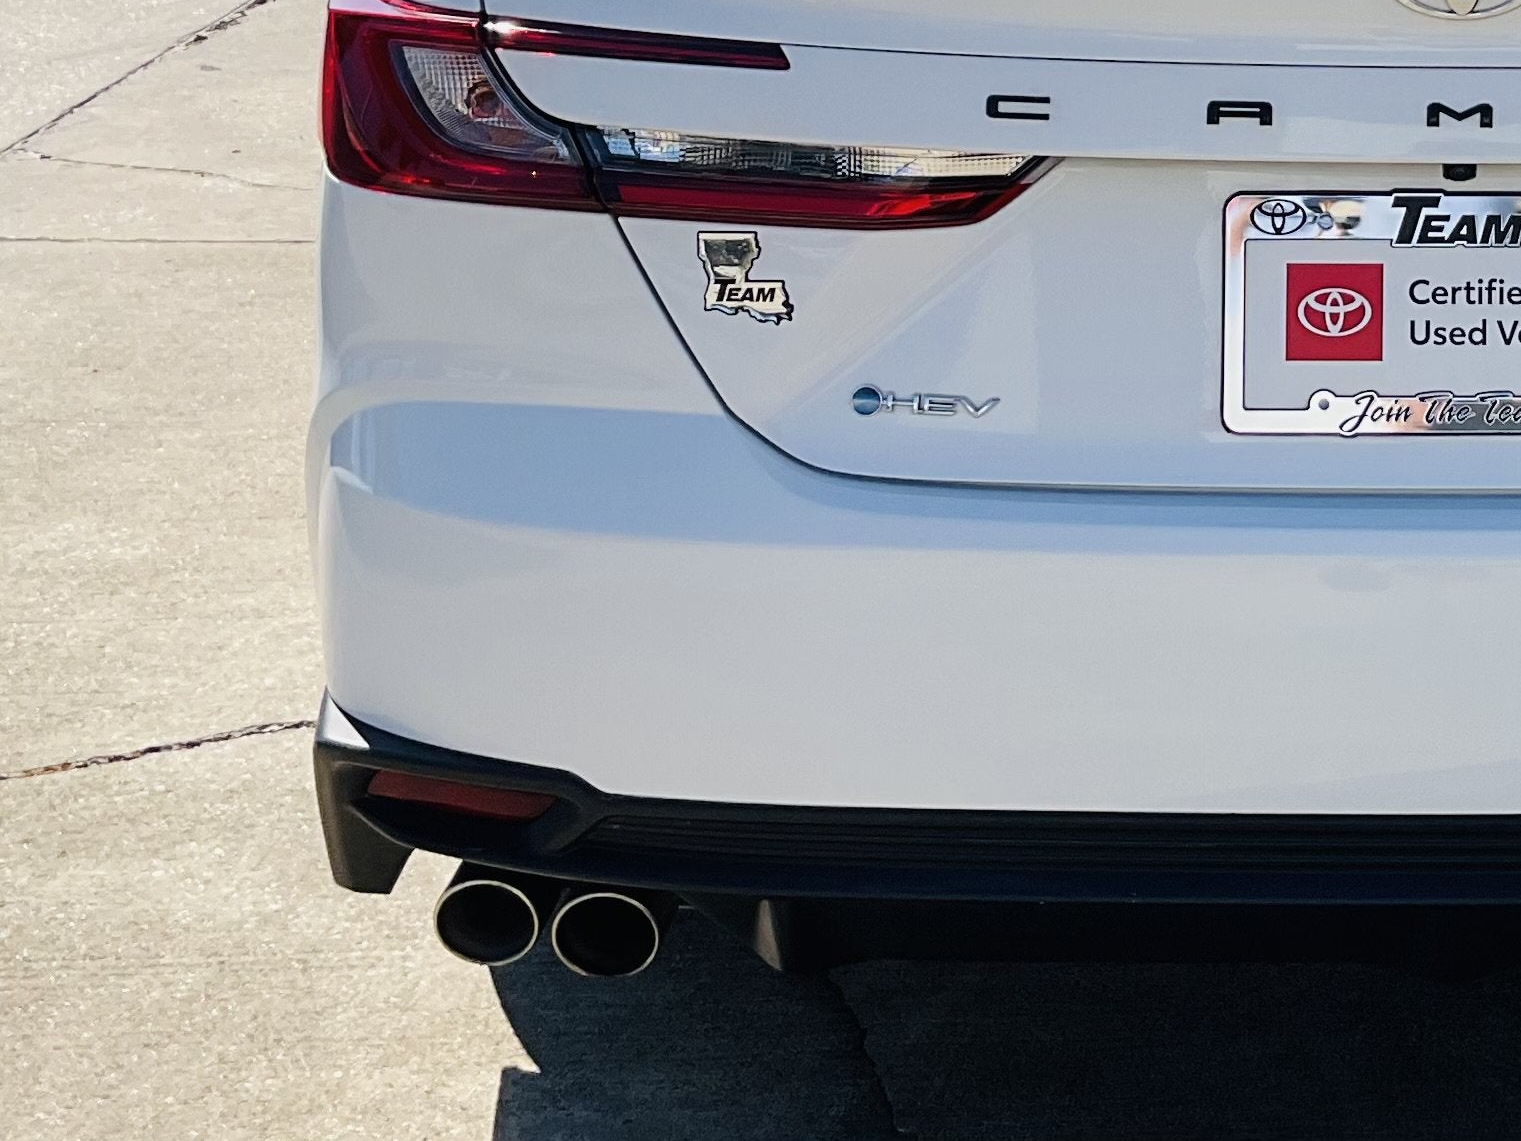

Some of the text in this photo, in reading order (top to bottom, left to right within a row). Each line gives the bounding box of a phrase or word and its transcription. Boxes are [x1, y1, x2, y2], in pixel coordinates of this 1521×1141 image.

[713, 278, 777, 303] TEAM
[1409, 319, 1488, 346] Used
[1340, 395, 1411, 433] Join
[1417, 392, 1476, 423] The
